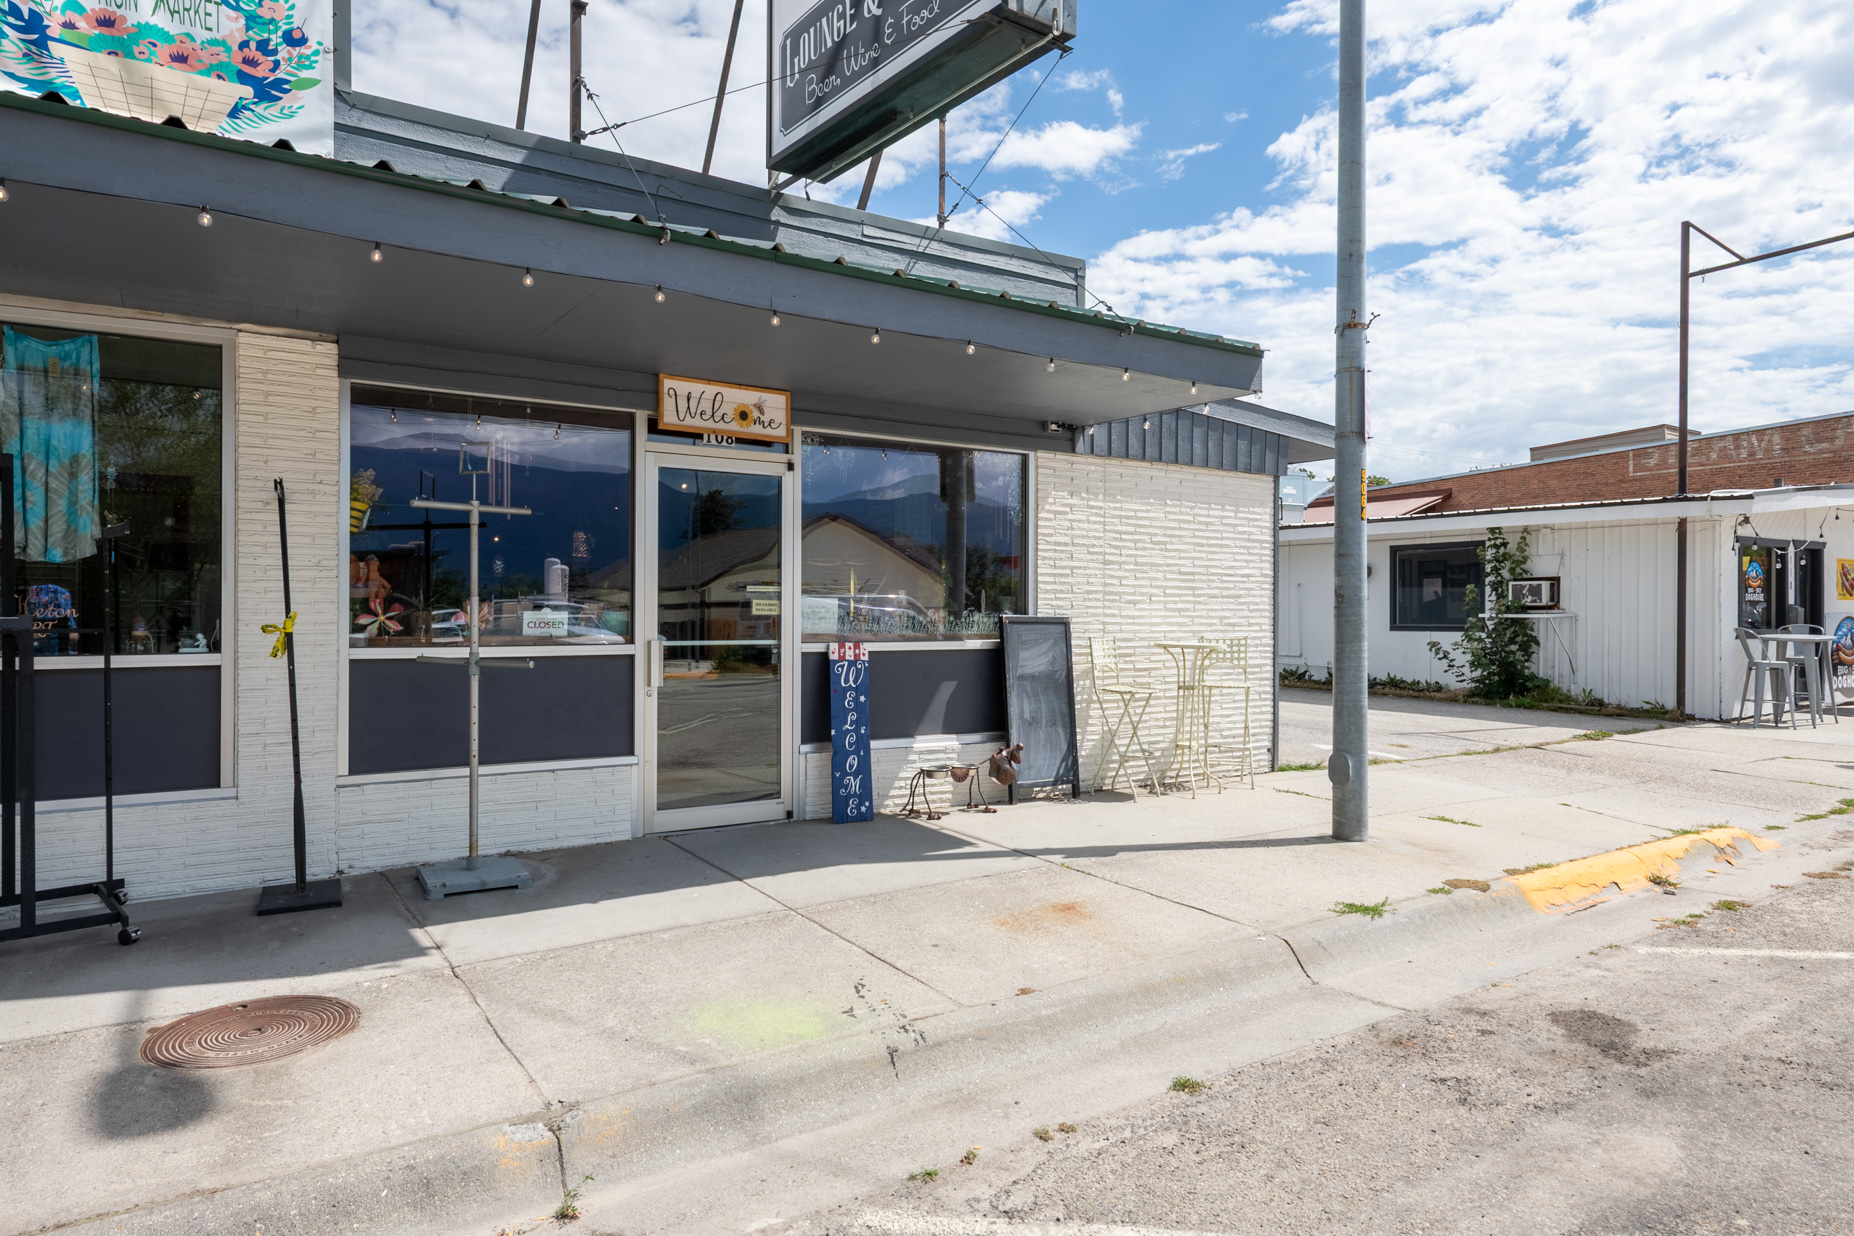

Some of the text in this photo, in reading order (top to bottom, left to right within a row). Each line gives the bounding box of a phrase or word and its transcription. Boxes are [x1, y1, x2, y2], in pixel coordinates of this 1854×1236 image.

[785, 0, 858, 88] LOUNGE
[804, 0, 940, 105] Beer, Wine & Food
[705, 434, 735, 446] 108
[527, 620, 565, 629] CLOSED
[1837, 665, 1849, 675] BIG
[834, 661, 865, 817] WELCOME
